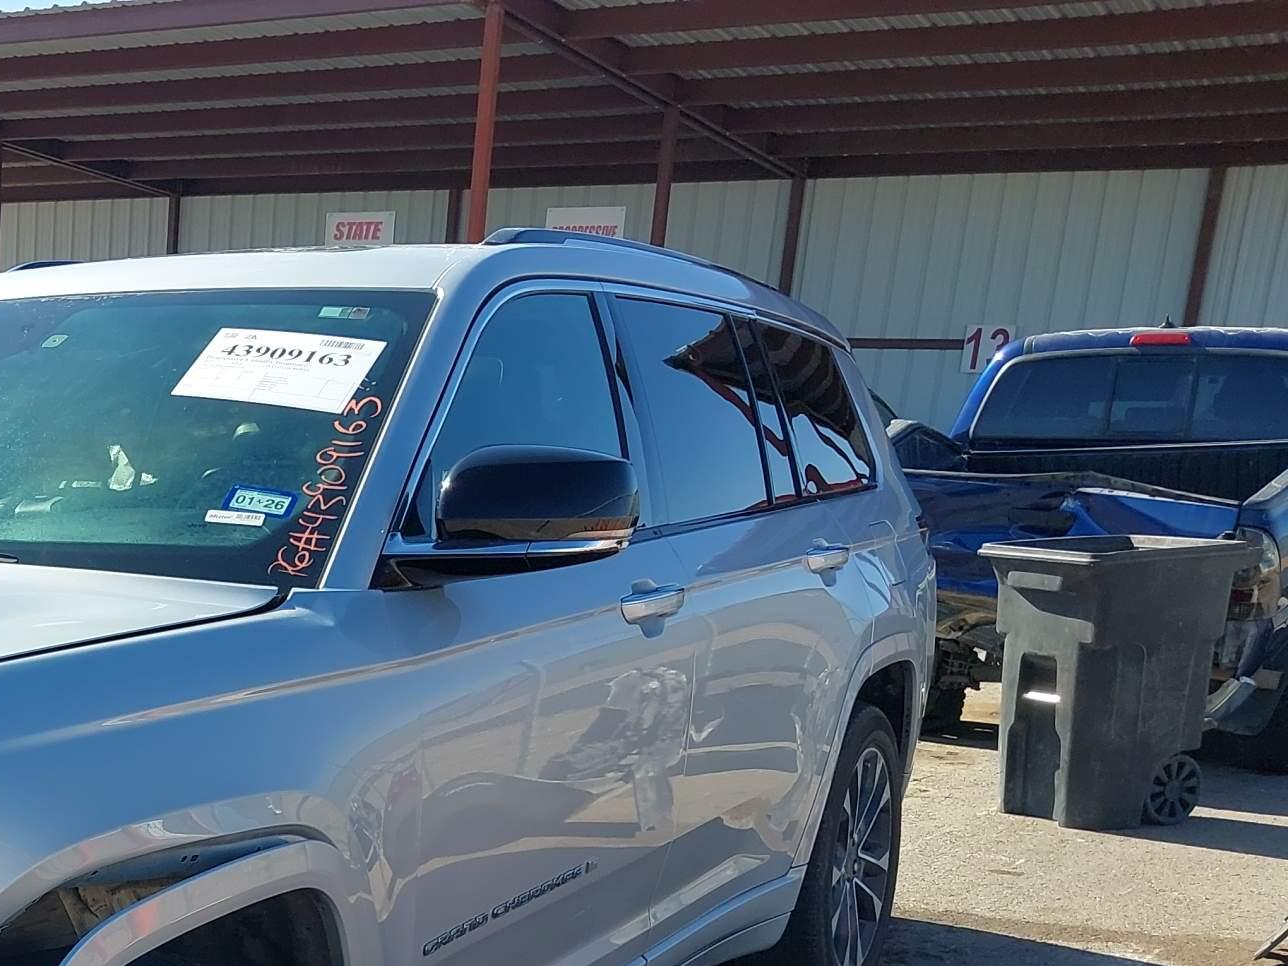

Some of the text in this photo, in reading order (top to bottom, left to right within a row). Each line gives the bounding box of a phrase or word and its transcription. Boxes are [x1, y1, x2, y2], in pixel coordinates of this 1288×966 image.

[333, 221, 384, 241] STATE
[220, 344, 353, 367] 43909163
[965, 327, 1010, 370] 13
